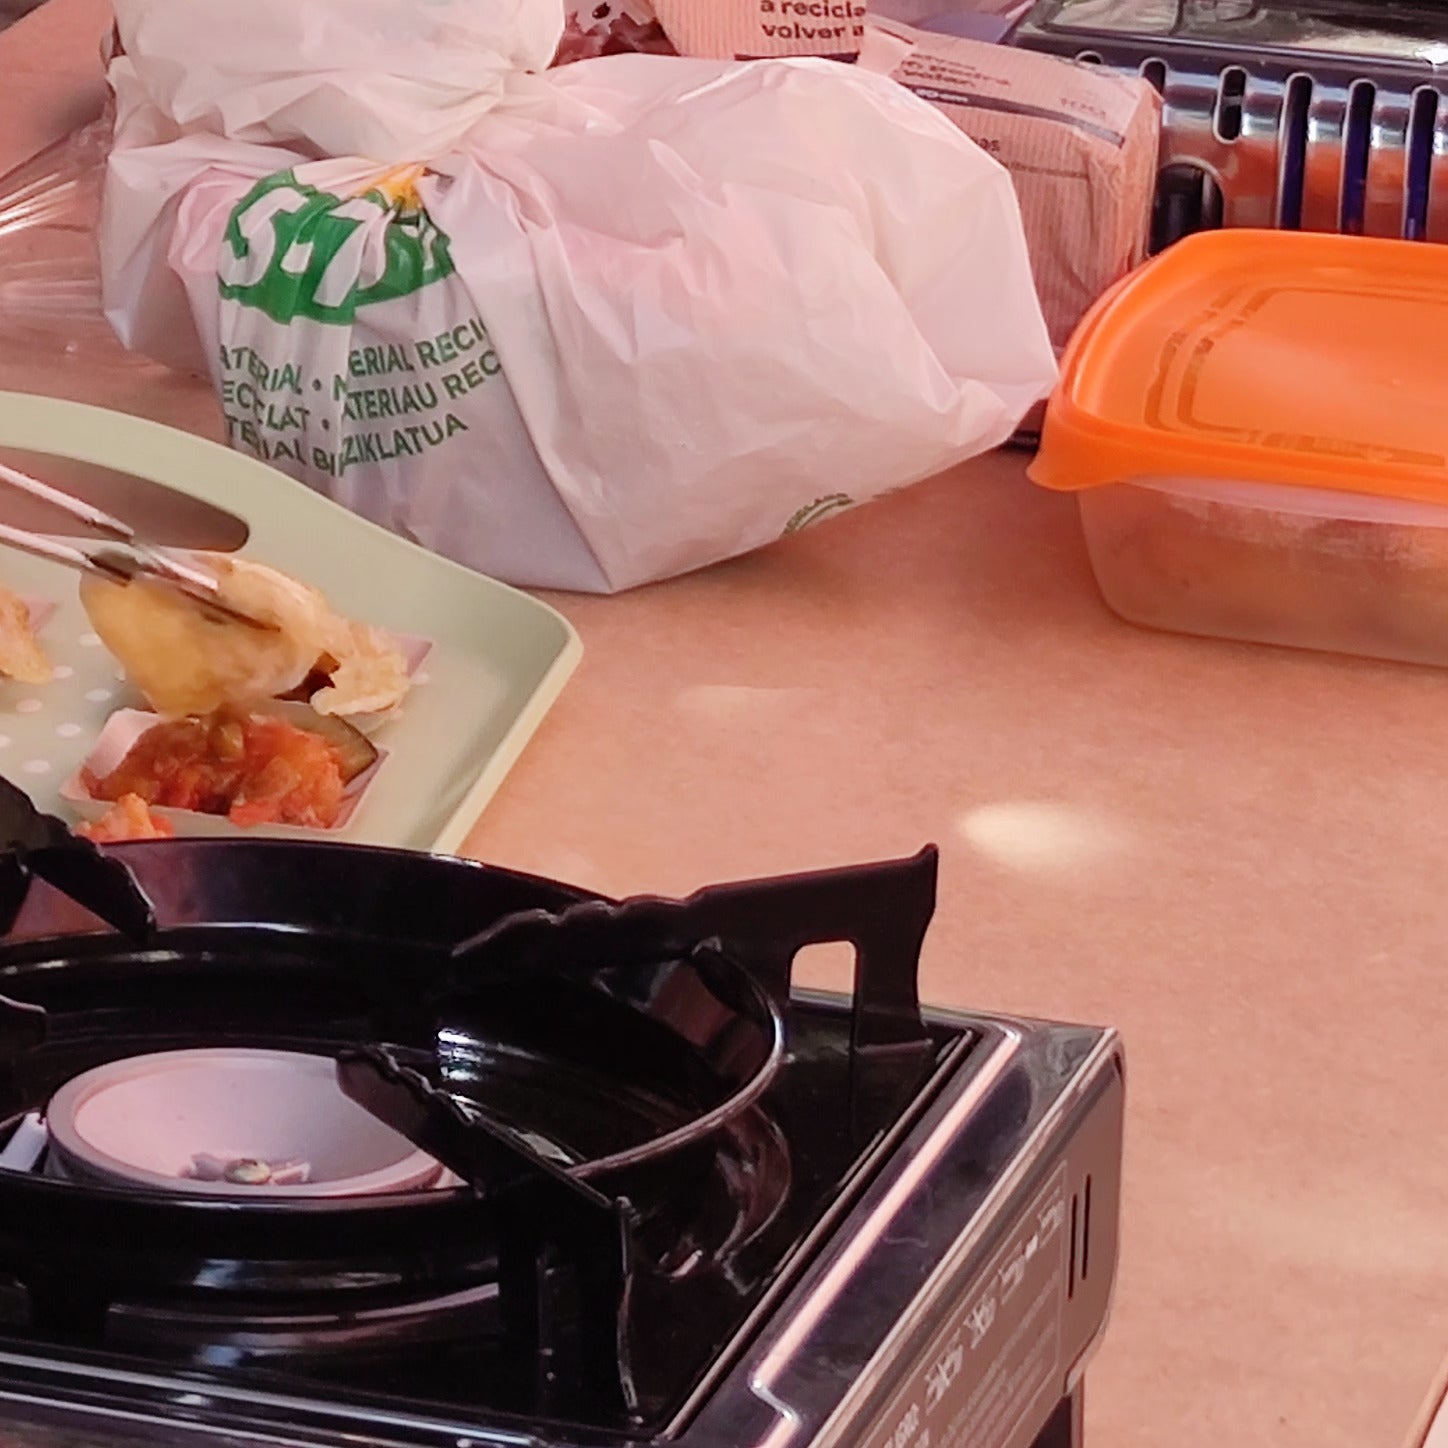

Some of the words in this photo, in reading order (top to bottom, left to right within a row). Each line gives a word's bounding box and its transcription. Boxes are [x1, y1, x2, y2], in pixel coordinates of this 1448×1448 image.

[760, 0, 775, 13] a
[761, 22, 846, 39] volver
[220, 344, 303, 396] ATERIAL
